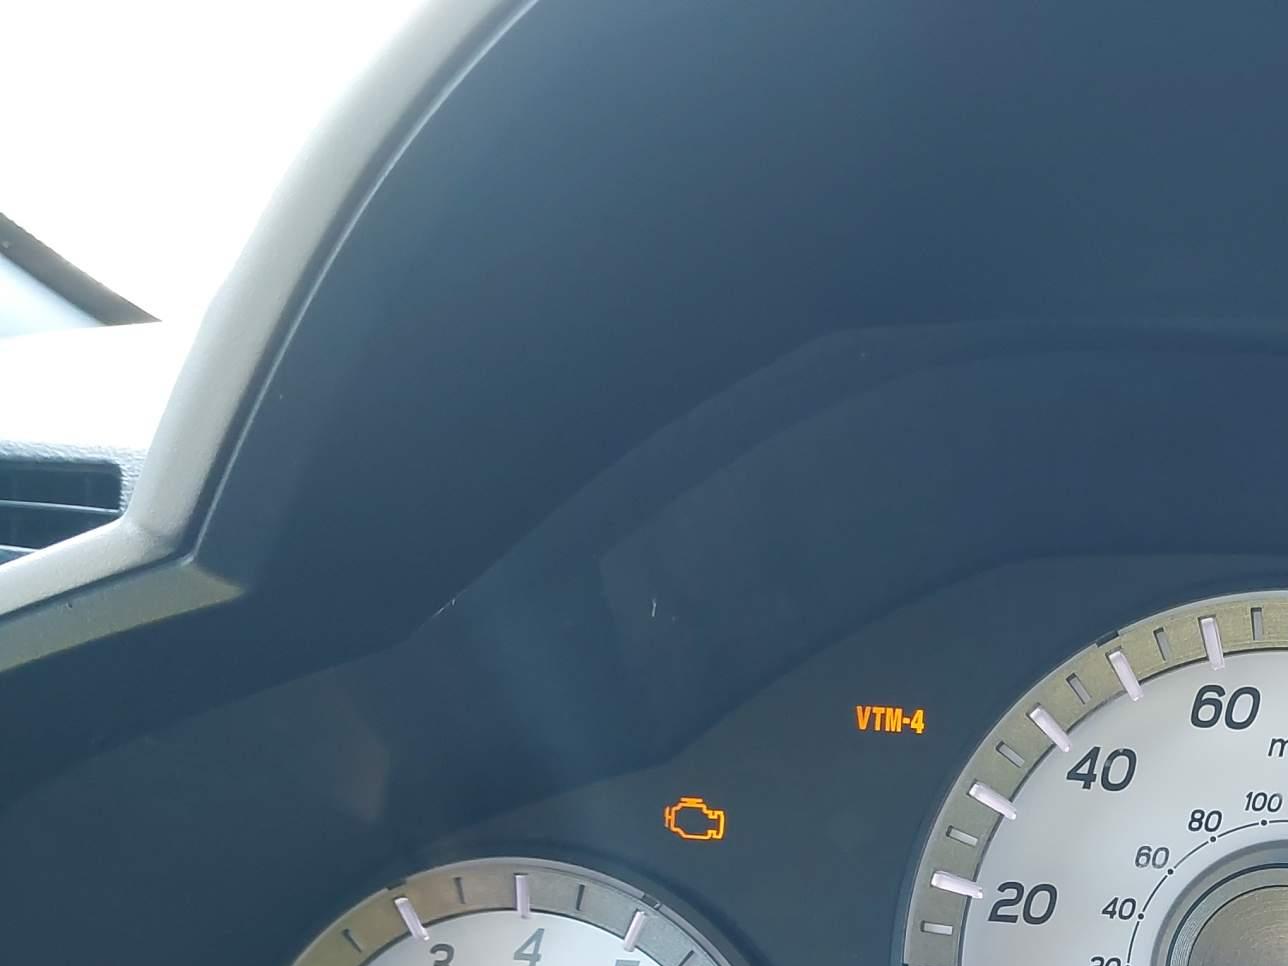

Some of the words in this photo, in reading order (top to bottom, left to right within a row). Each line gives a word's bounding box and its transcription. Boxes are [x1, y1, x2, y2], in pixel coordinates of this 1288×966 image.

[856, 706, 925, 733] VTM-4
[1191, 685, 1260, 731] 60
[1066, 747, 1137, 792] 40
[1244, 792, 1283, 814] 100
[1188, 809, 1222, 834] 80
[1135, 846, 1169, 870] 60
[989, 882, 1058, 926] 20
[1102, 897, 1137, 921] 40
